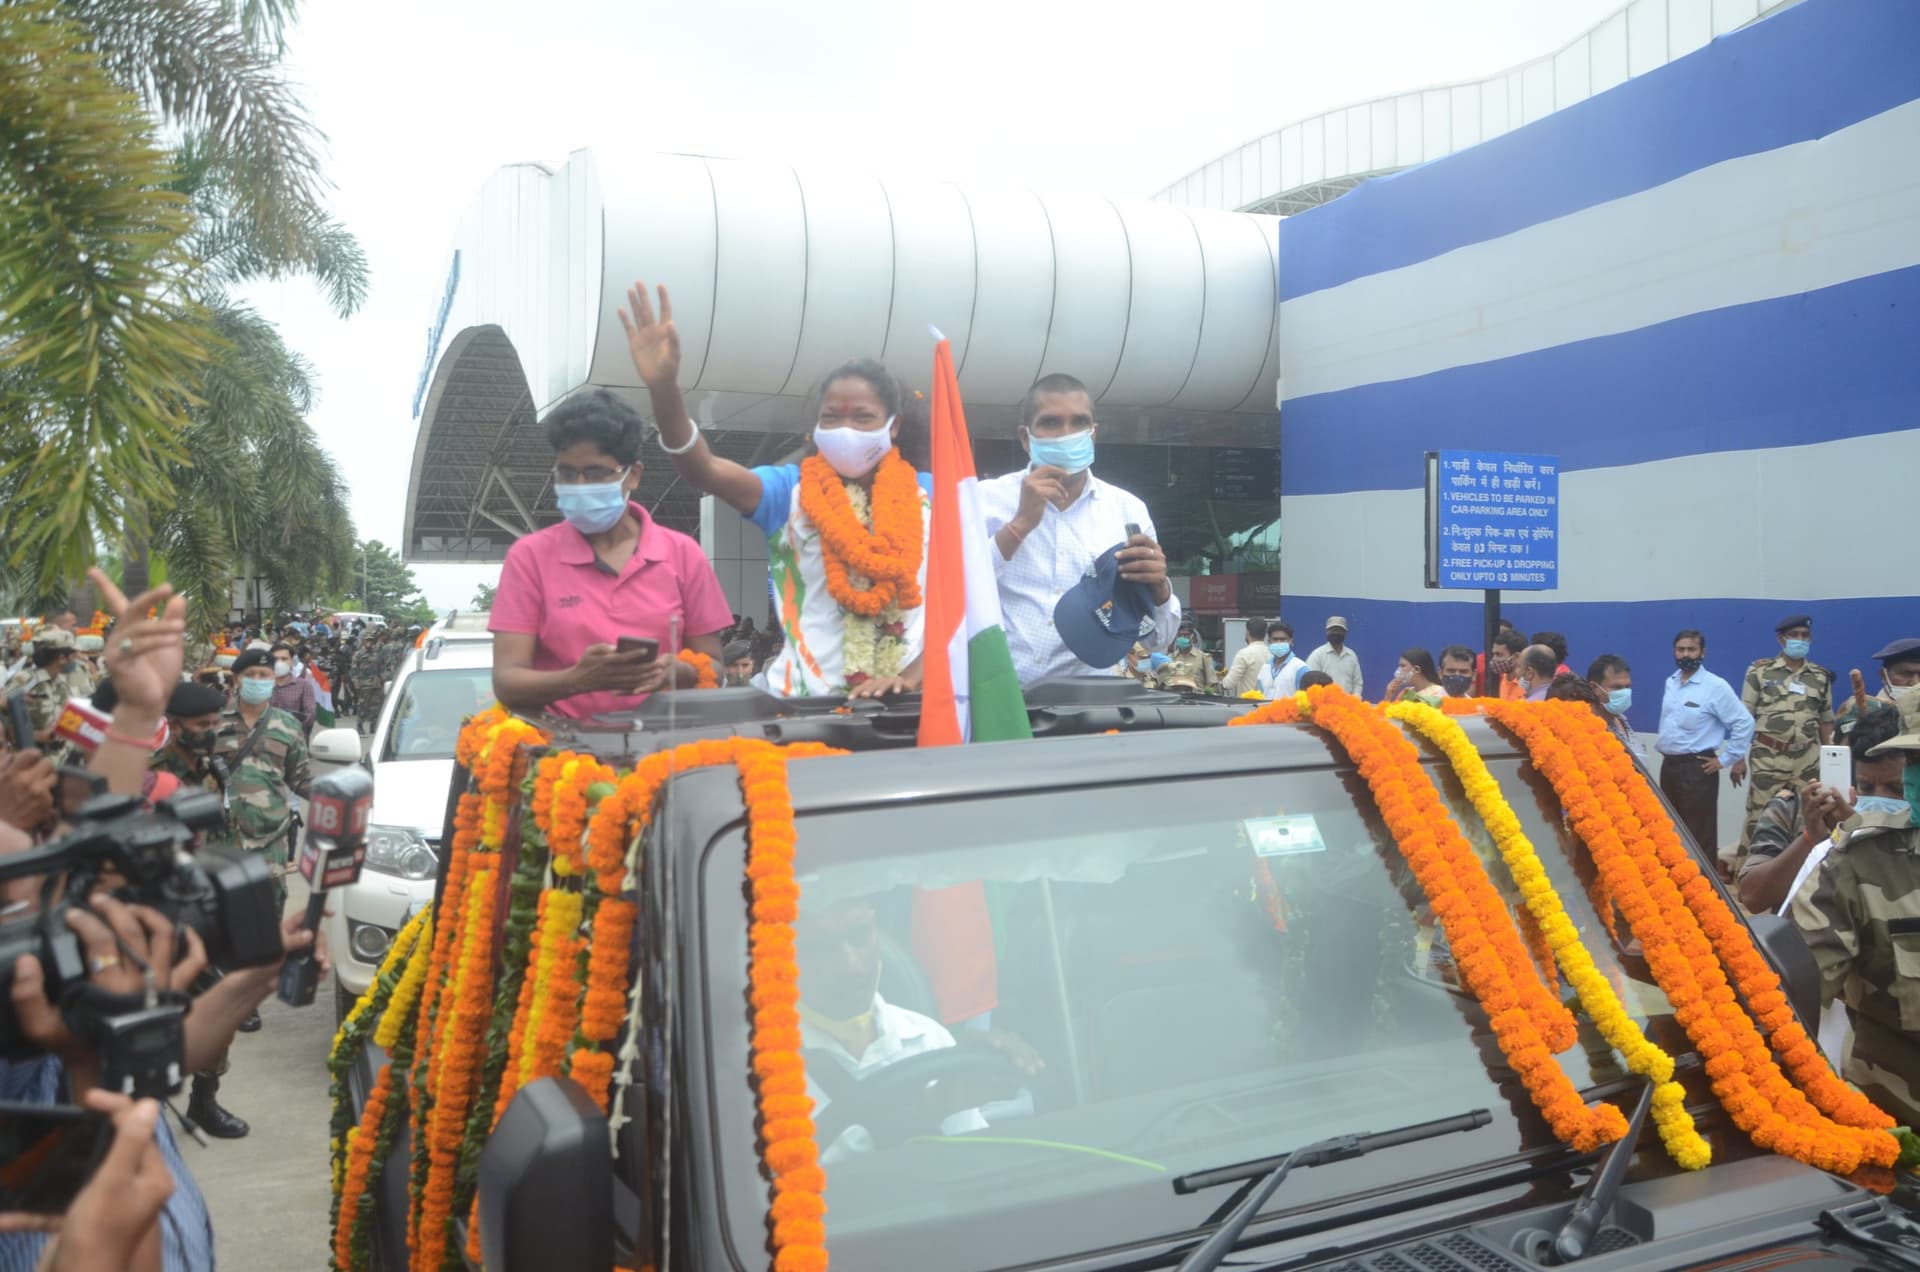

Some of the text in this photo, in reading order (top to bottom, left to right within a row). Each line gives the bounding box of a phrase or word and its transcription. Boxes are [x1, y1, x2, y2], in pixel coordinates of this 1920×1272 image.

[1451, 492, 1489, 502] VEHICLES
[1491, 493, 1501, 502] TO
[1503, 494, 1514, 503] BE
[1516, 495, 1546, 505] PARKED
[1548, 496, 1556, 505] IN
[1451, 505, 1549, 518] CAR-PARKING AREA ONLY
[1451, 559, 1472, 568] FREE
[1473, 559, 1505, 569] PICK-UP
[1507, 560, 1513, 569] &
[1514, 560, 1555, 570] DROPPING
[1451, 571, 1472, 581] ONLY
[1473, 572, 1495, 582] UPTO
[1511, 573, 1546, 583] MINUTES
[314, 801, 337, 829] 18
